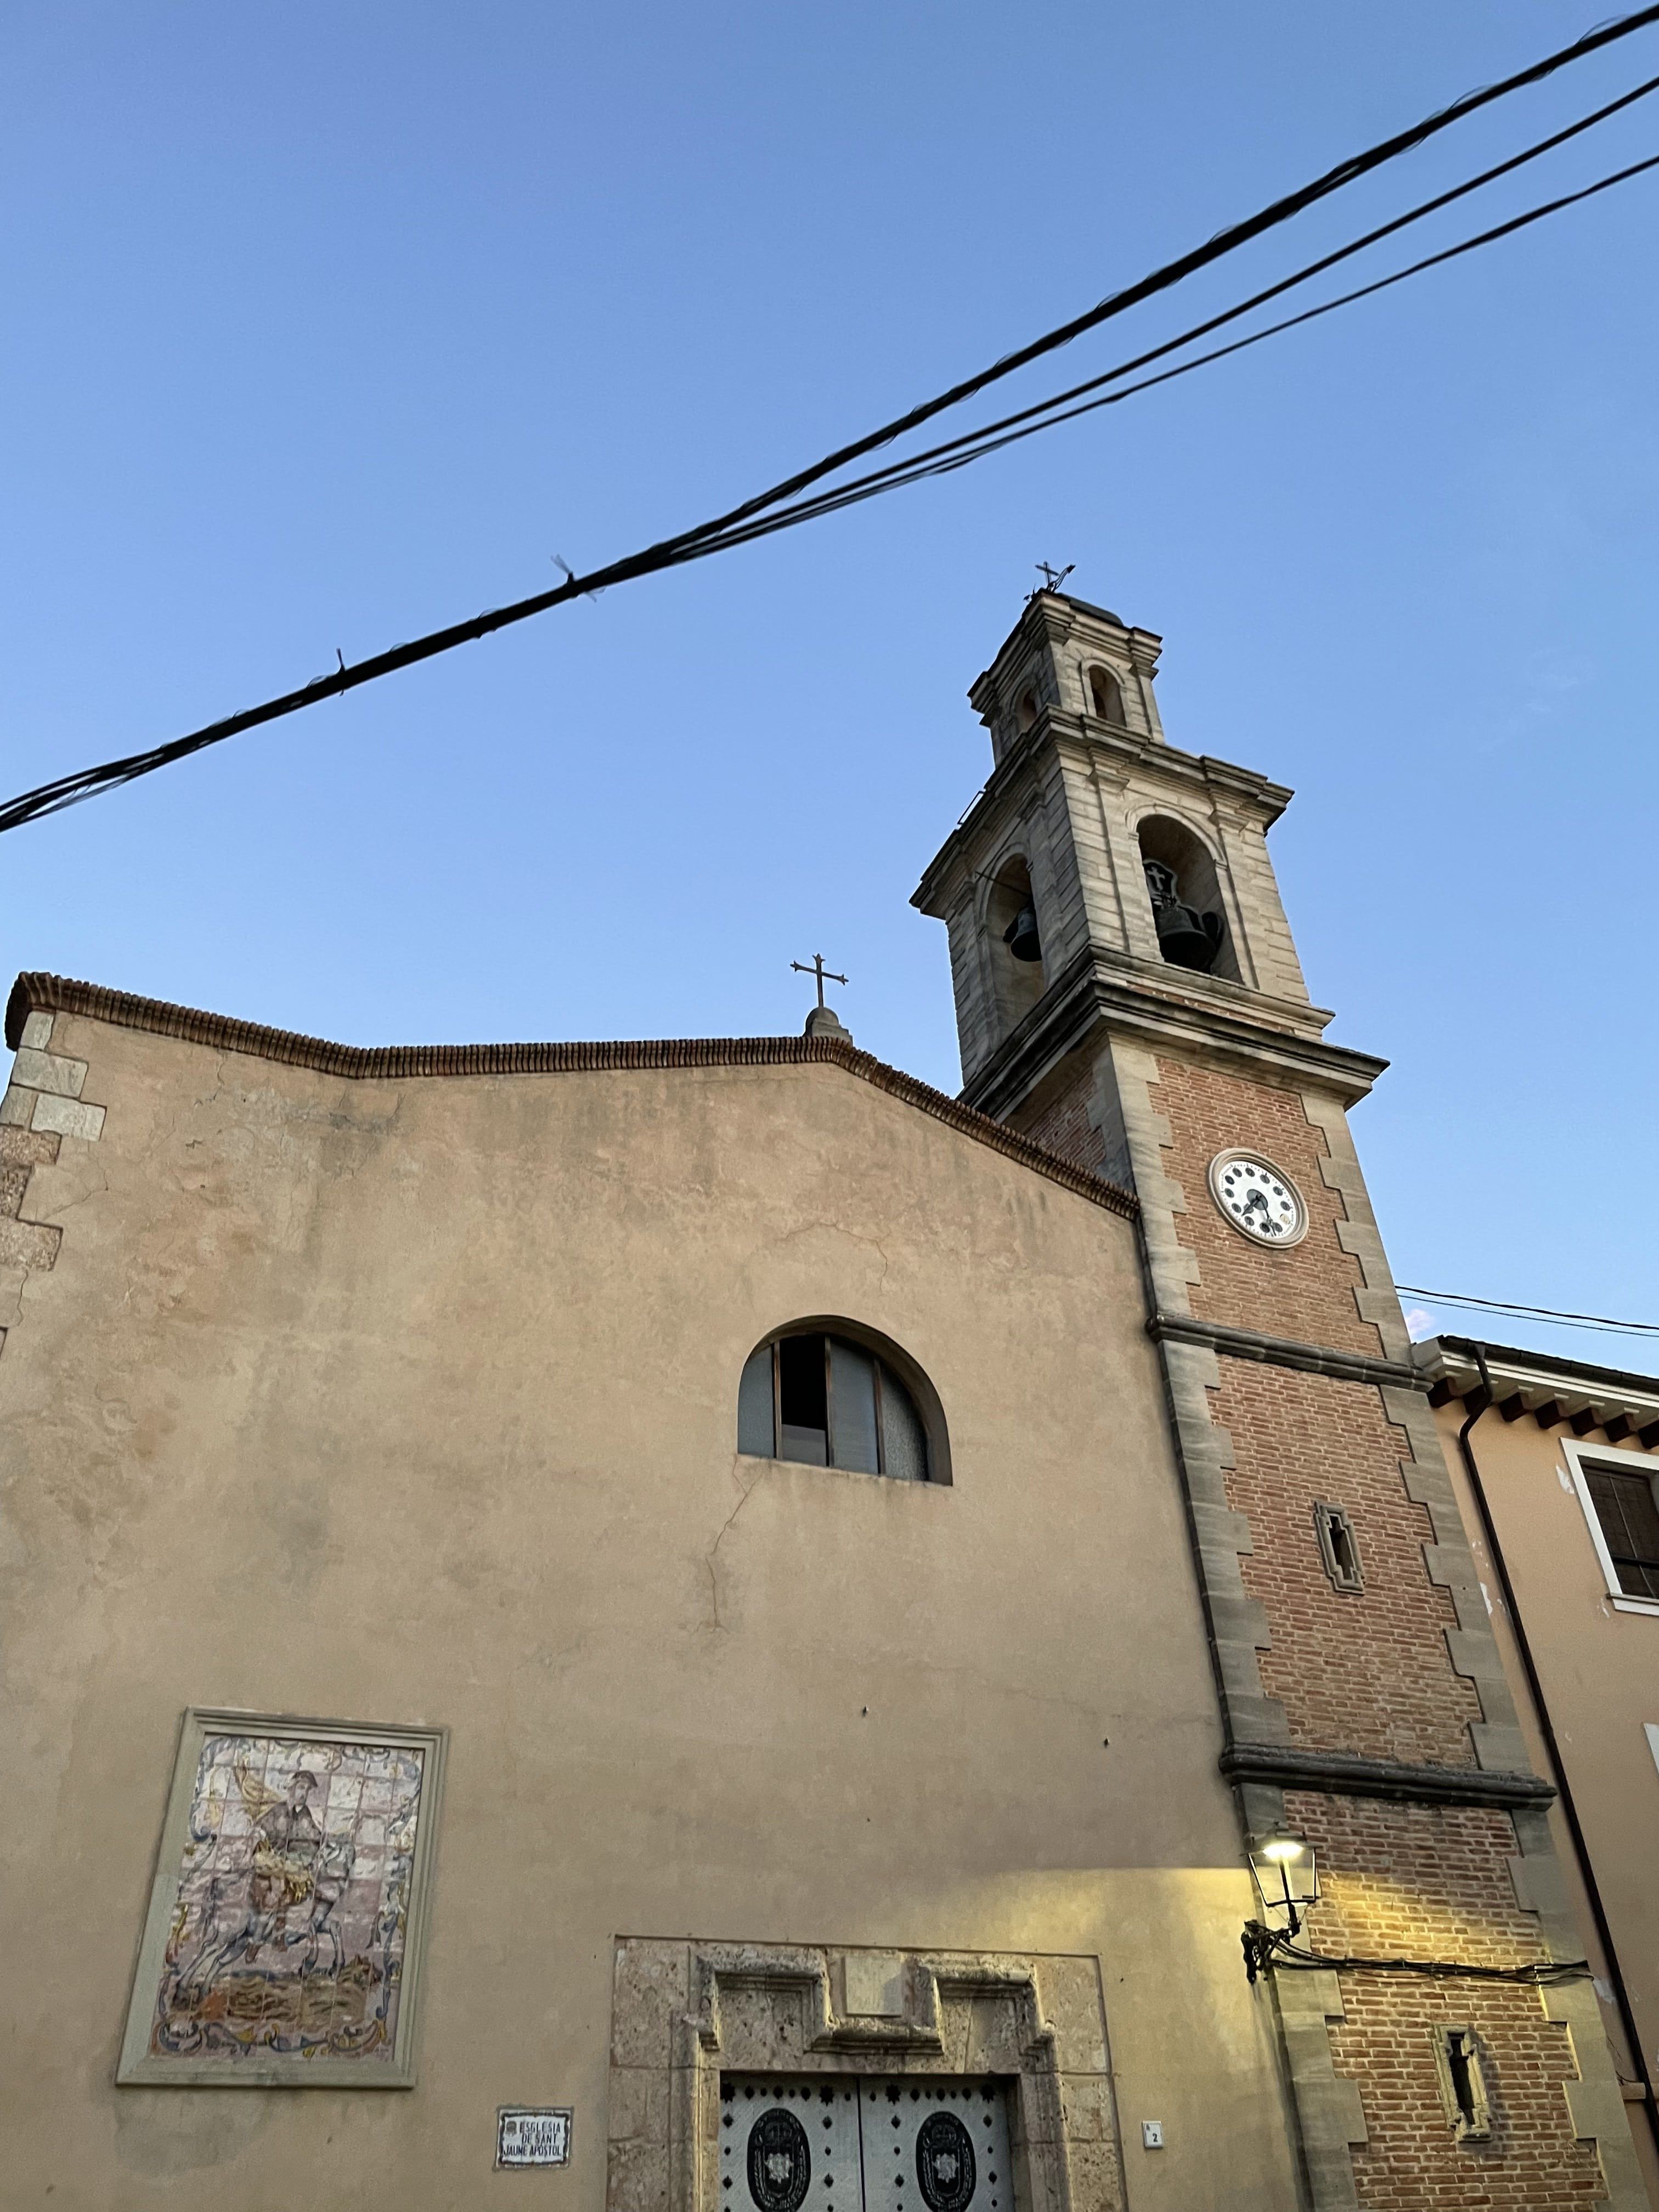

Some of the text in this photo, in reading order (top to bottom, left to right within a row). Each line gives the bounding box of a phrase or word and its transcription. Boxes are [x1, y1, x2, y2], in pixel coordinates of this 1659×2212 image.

[520, 2121, 561, 2133] ESGLESIA
[522, 2133, 557, 2145] DE SANT
[1152, 2132, 1158, 2142] 2
[504, 2144, 527, 2156] JAUME
